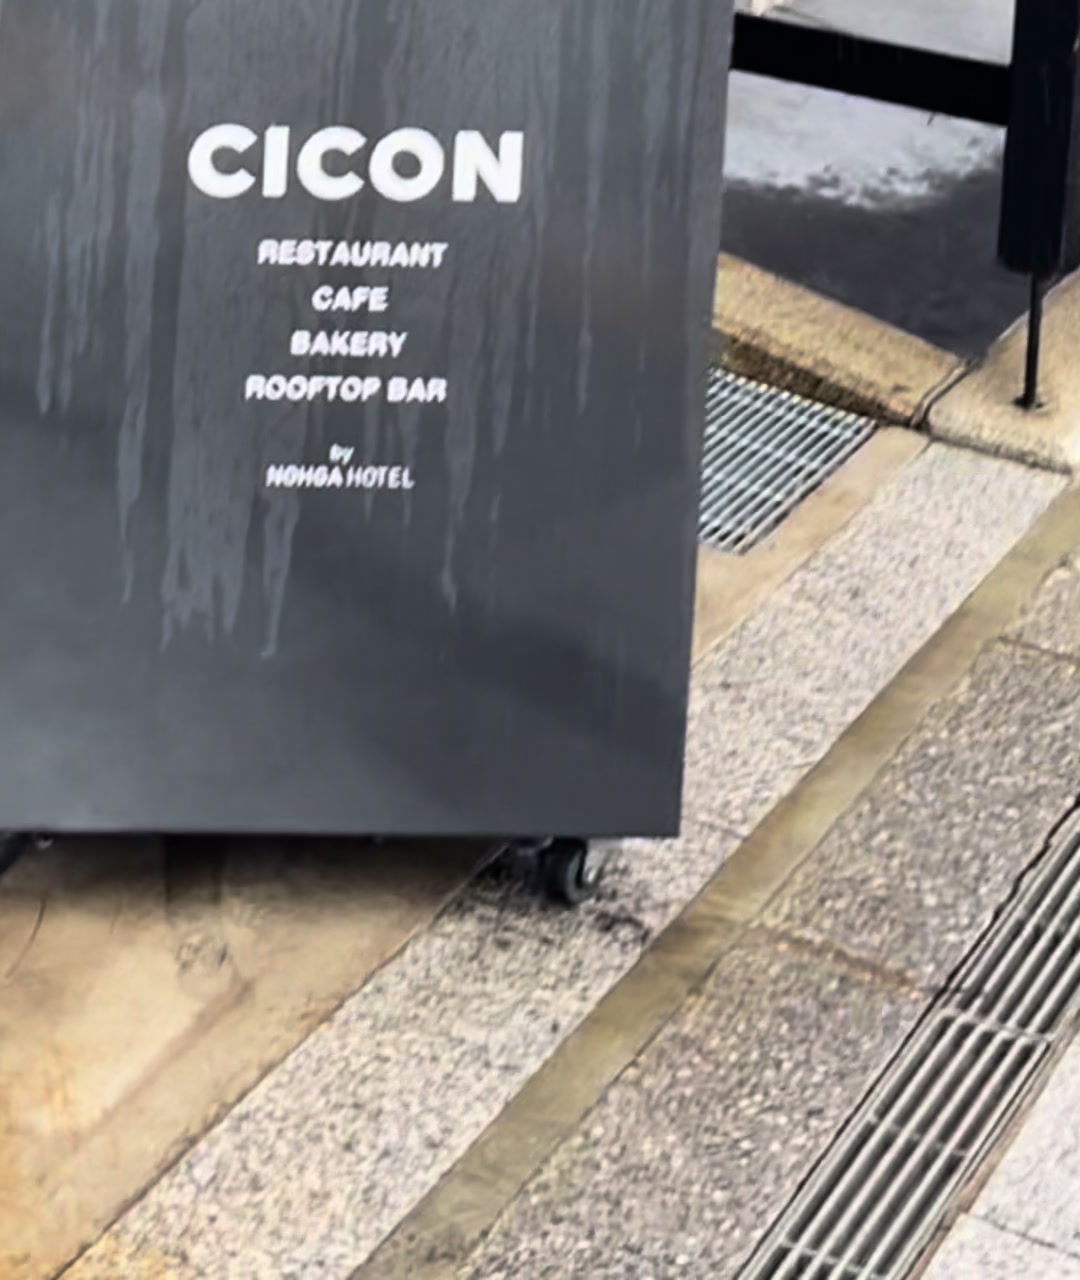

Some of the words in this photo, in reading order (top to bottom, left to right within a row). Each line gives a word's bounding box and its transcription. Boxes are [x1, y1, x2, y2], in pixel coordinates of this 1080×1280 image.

[187, 123, 524, 203] CICON
[257, 239, 448, 268] RESTAURANT
[311, 286, 388, 312] CAFE
[290, 330, 407, 358] BAKERY
[245, 374, 379, 401] ROOFTOP
[387, 376, 447, 403] BAR
[329, 443, 354, 465] by
[266, 465, 344, 488] NOHGA
[346, 466, 415, 489] HOTEL
